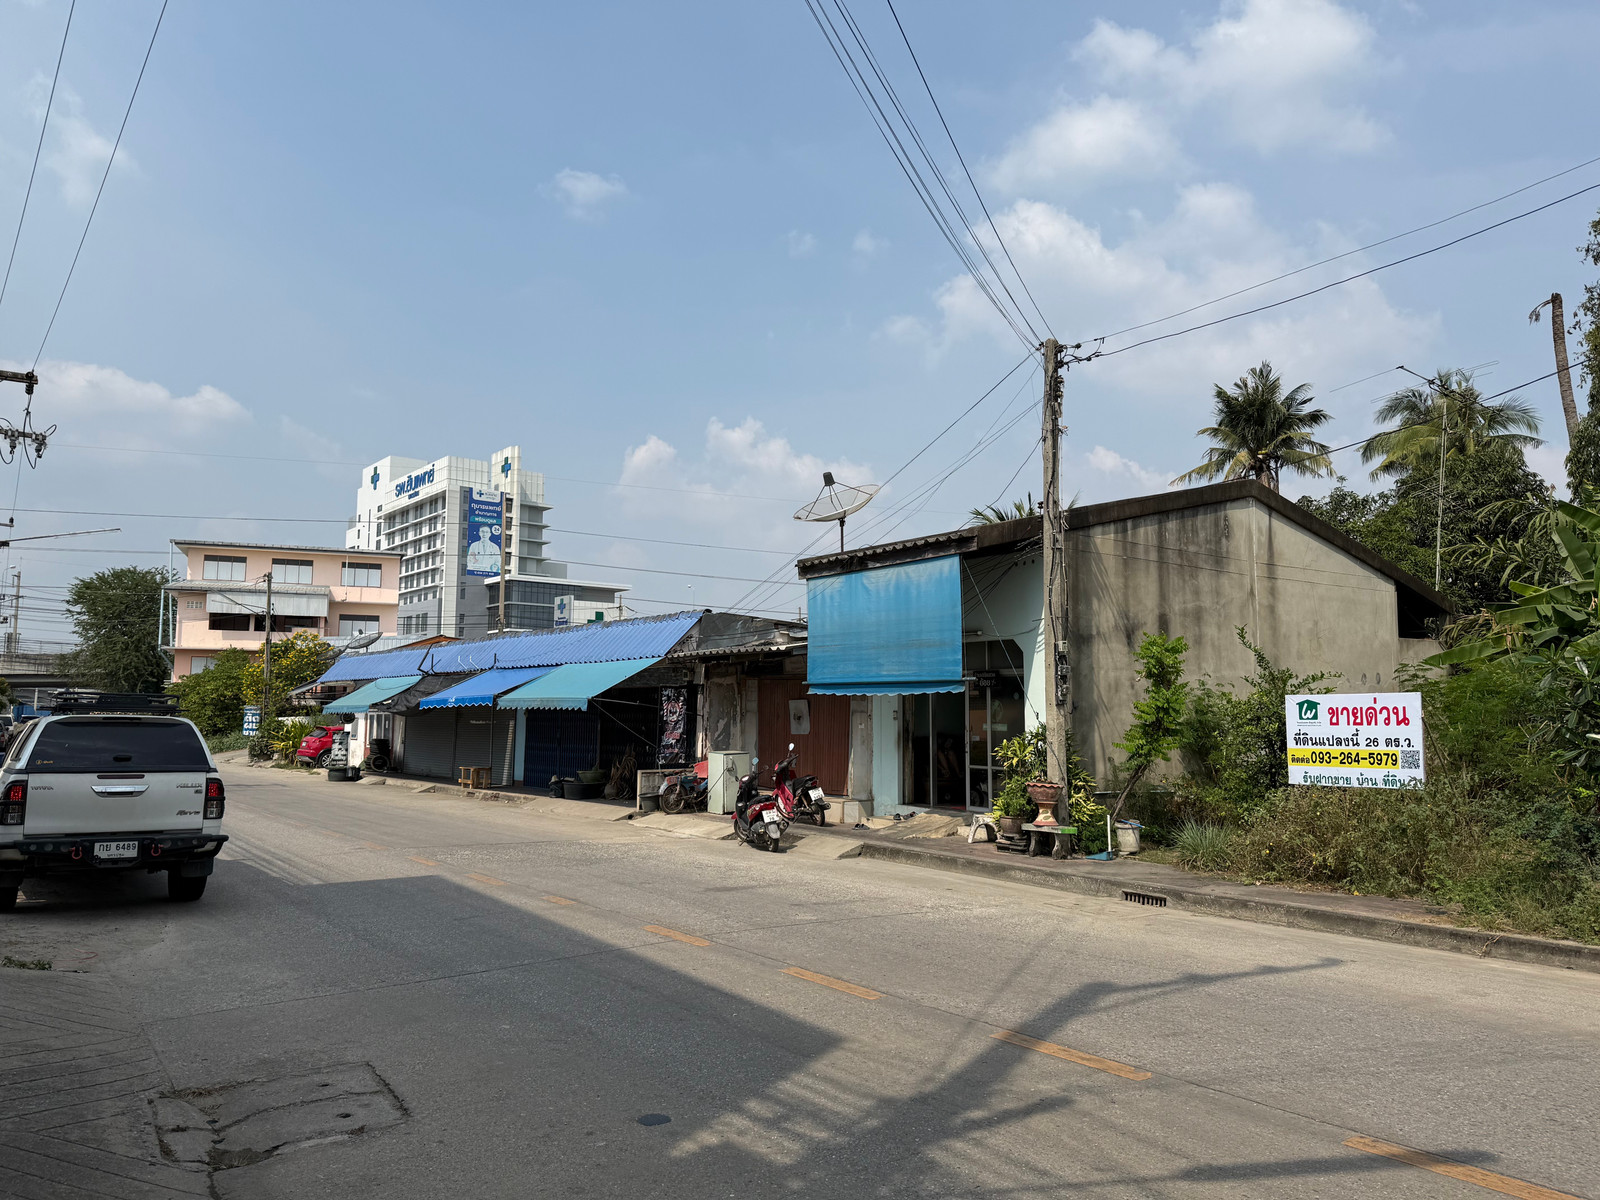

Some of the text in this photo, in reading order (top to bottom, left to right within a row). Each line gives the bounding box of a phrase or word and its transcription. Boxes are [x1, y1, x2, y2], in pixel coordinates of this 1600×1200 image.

[1328, 697, 1410, 727] ขายด่วน
[1293, 728, 1415, 748] ที่ดินแปลงนี้ 26 ตร.ว.
[1291, 751, 1398, 766] ติดต่อ 093-264-5979
[1302, 770, 1352, 786] รับฝากขาย
[1356, 772, 1378, 787] บ้าน
[99, 842, 137, 852] กย 6489
